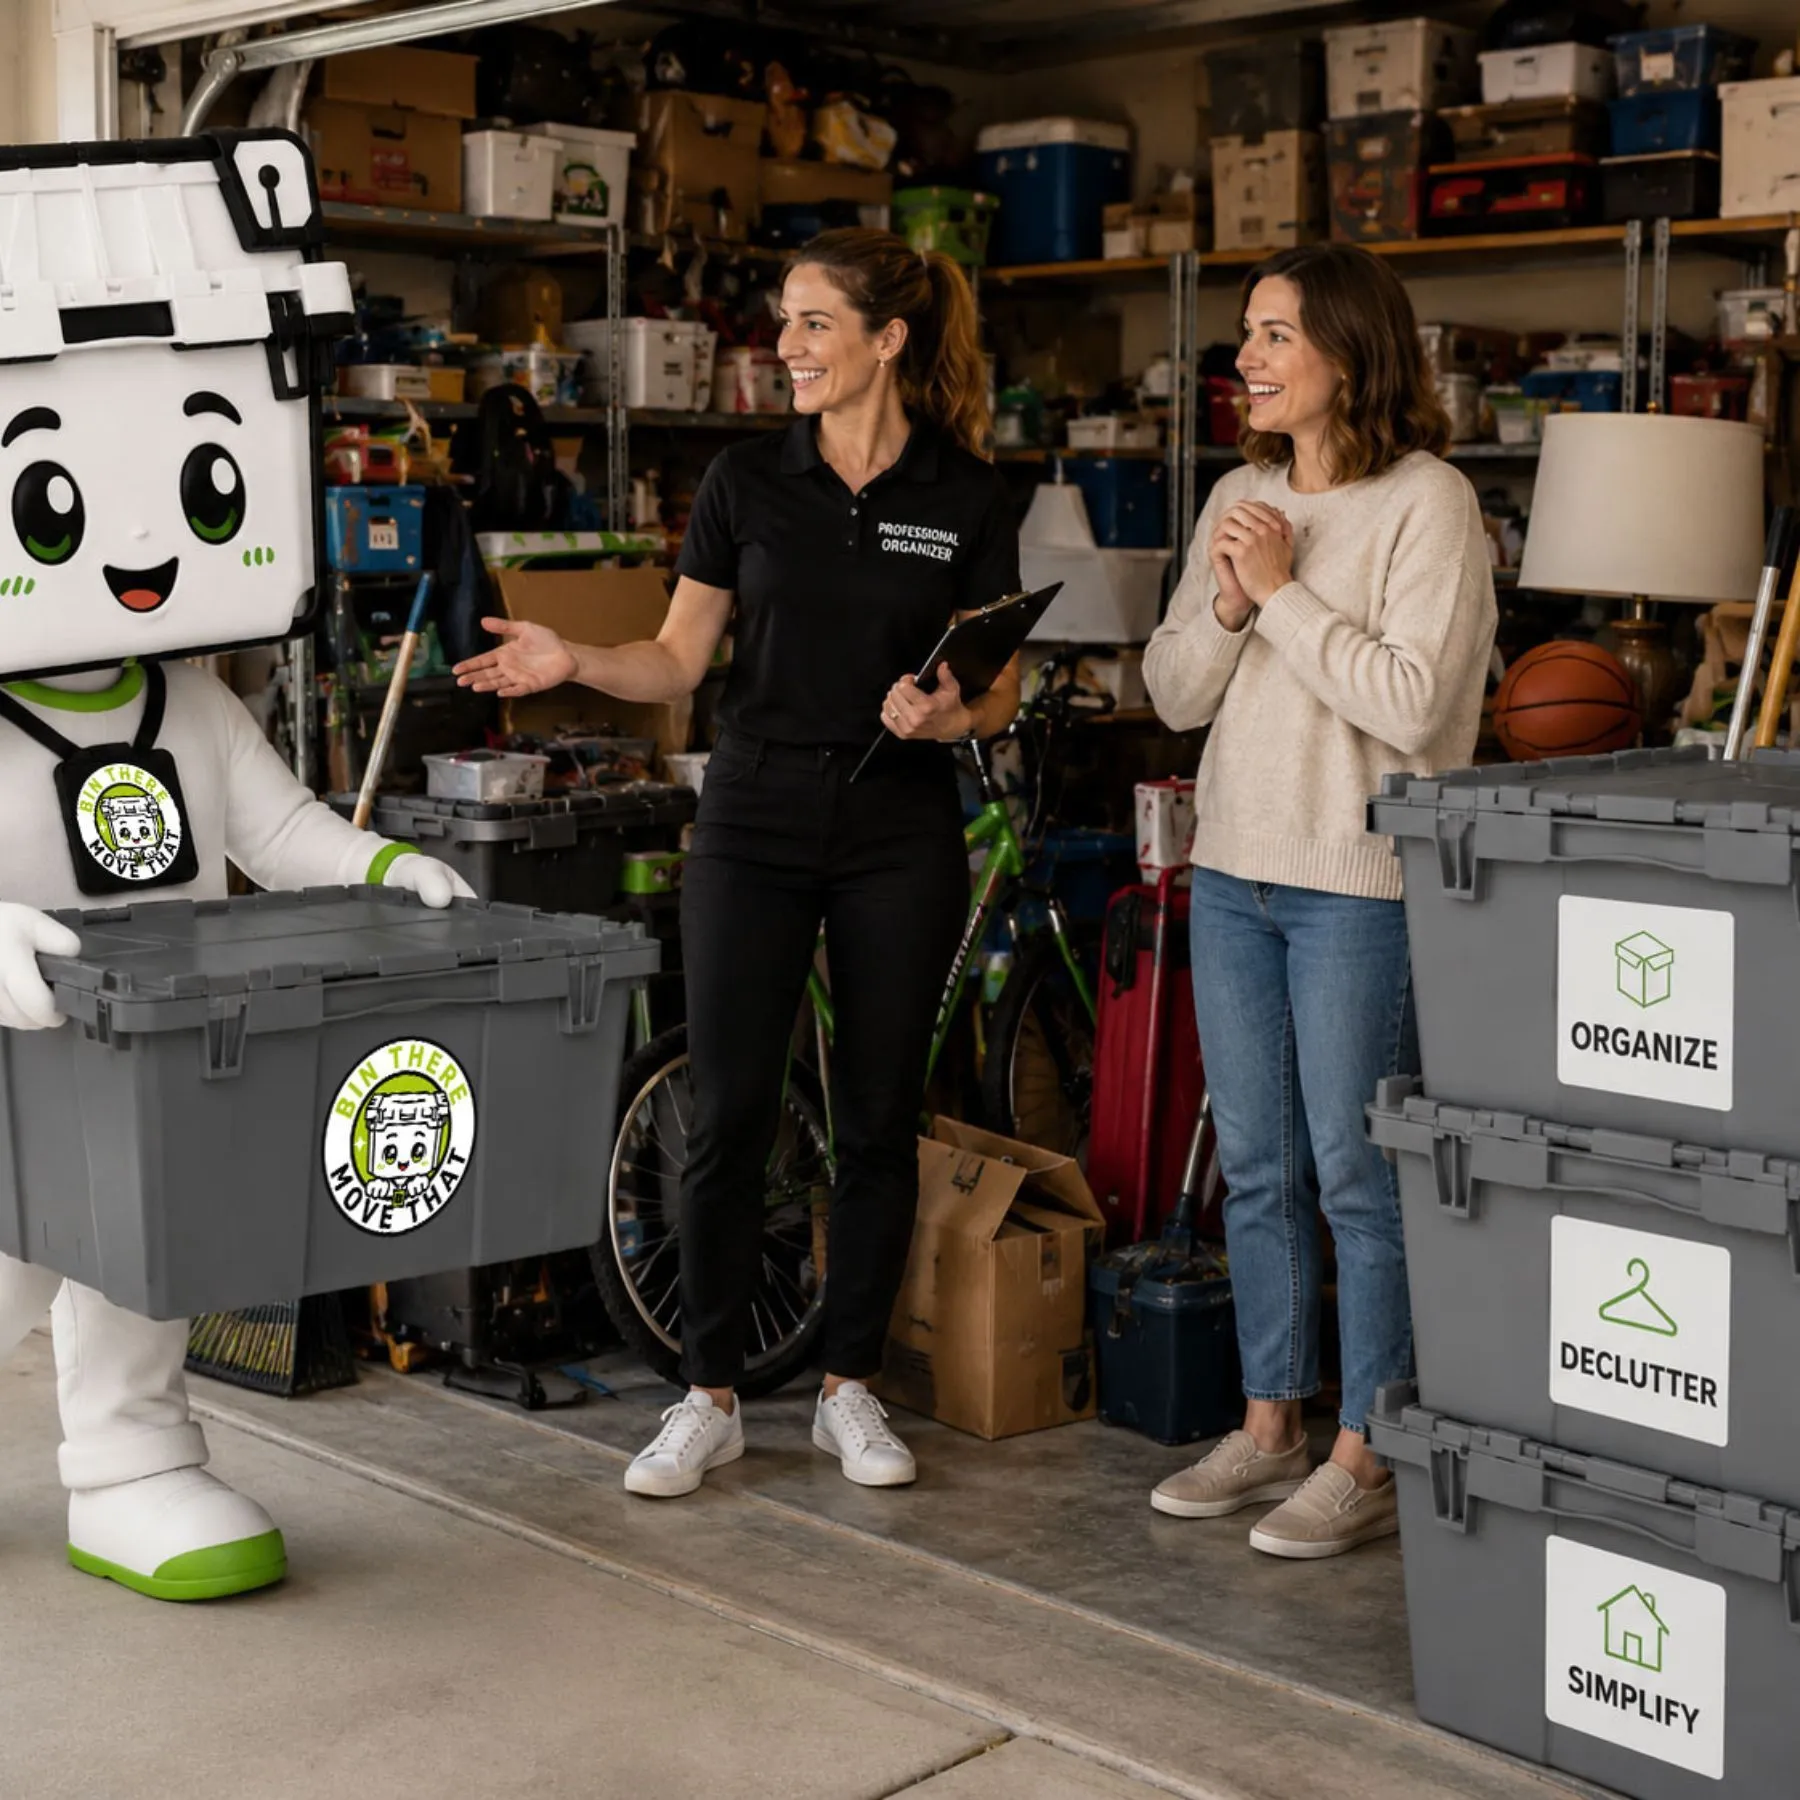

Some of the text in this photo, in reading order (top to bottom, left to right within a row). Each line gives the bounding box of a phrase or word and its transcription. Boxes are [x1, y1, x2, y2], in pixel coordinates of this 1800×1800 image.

[878, 522, 959, 546] PROFESSIONAL
[881, 538, 952, 562] ORGANIZER
[80, 766, 168, 813] BIN THERE
[89, 828, 179, 878] MOVE THAT
[1571, 1021, 1718, 1071] ORGANIZE
[336, 1045, 468, 1120] BIN THERE
[330, 1146, 465, 1229] MOVE THAT
[1561, 1341, 1717, 1408] DECLUTTER
[1568, 1665, 1700, 1735] SIMPLIFY
